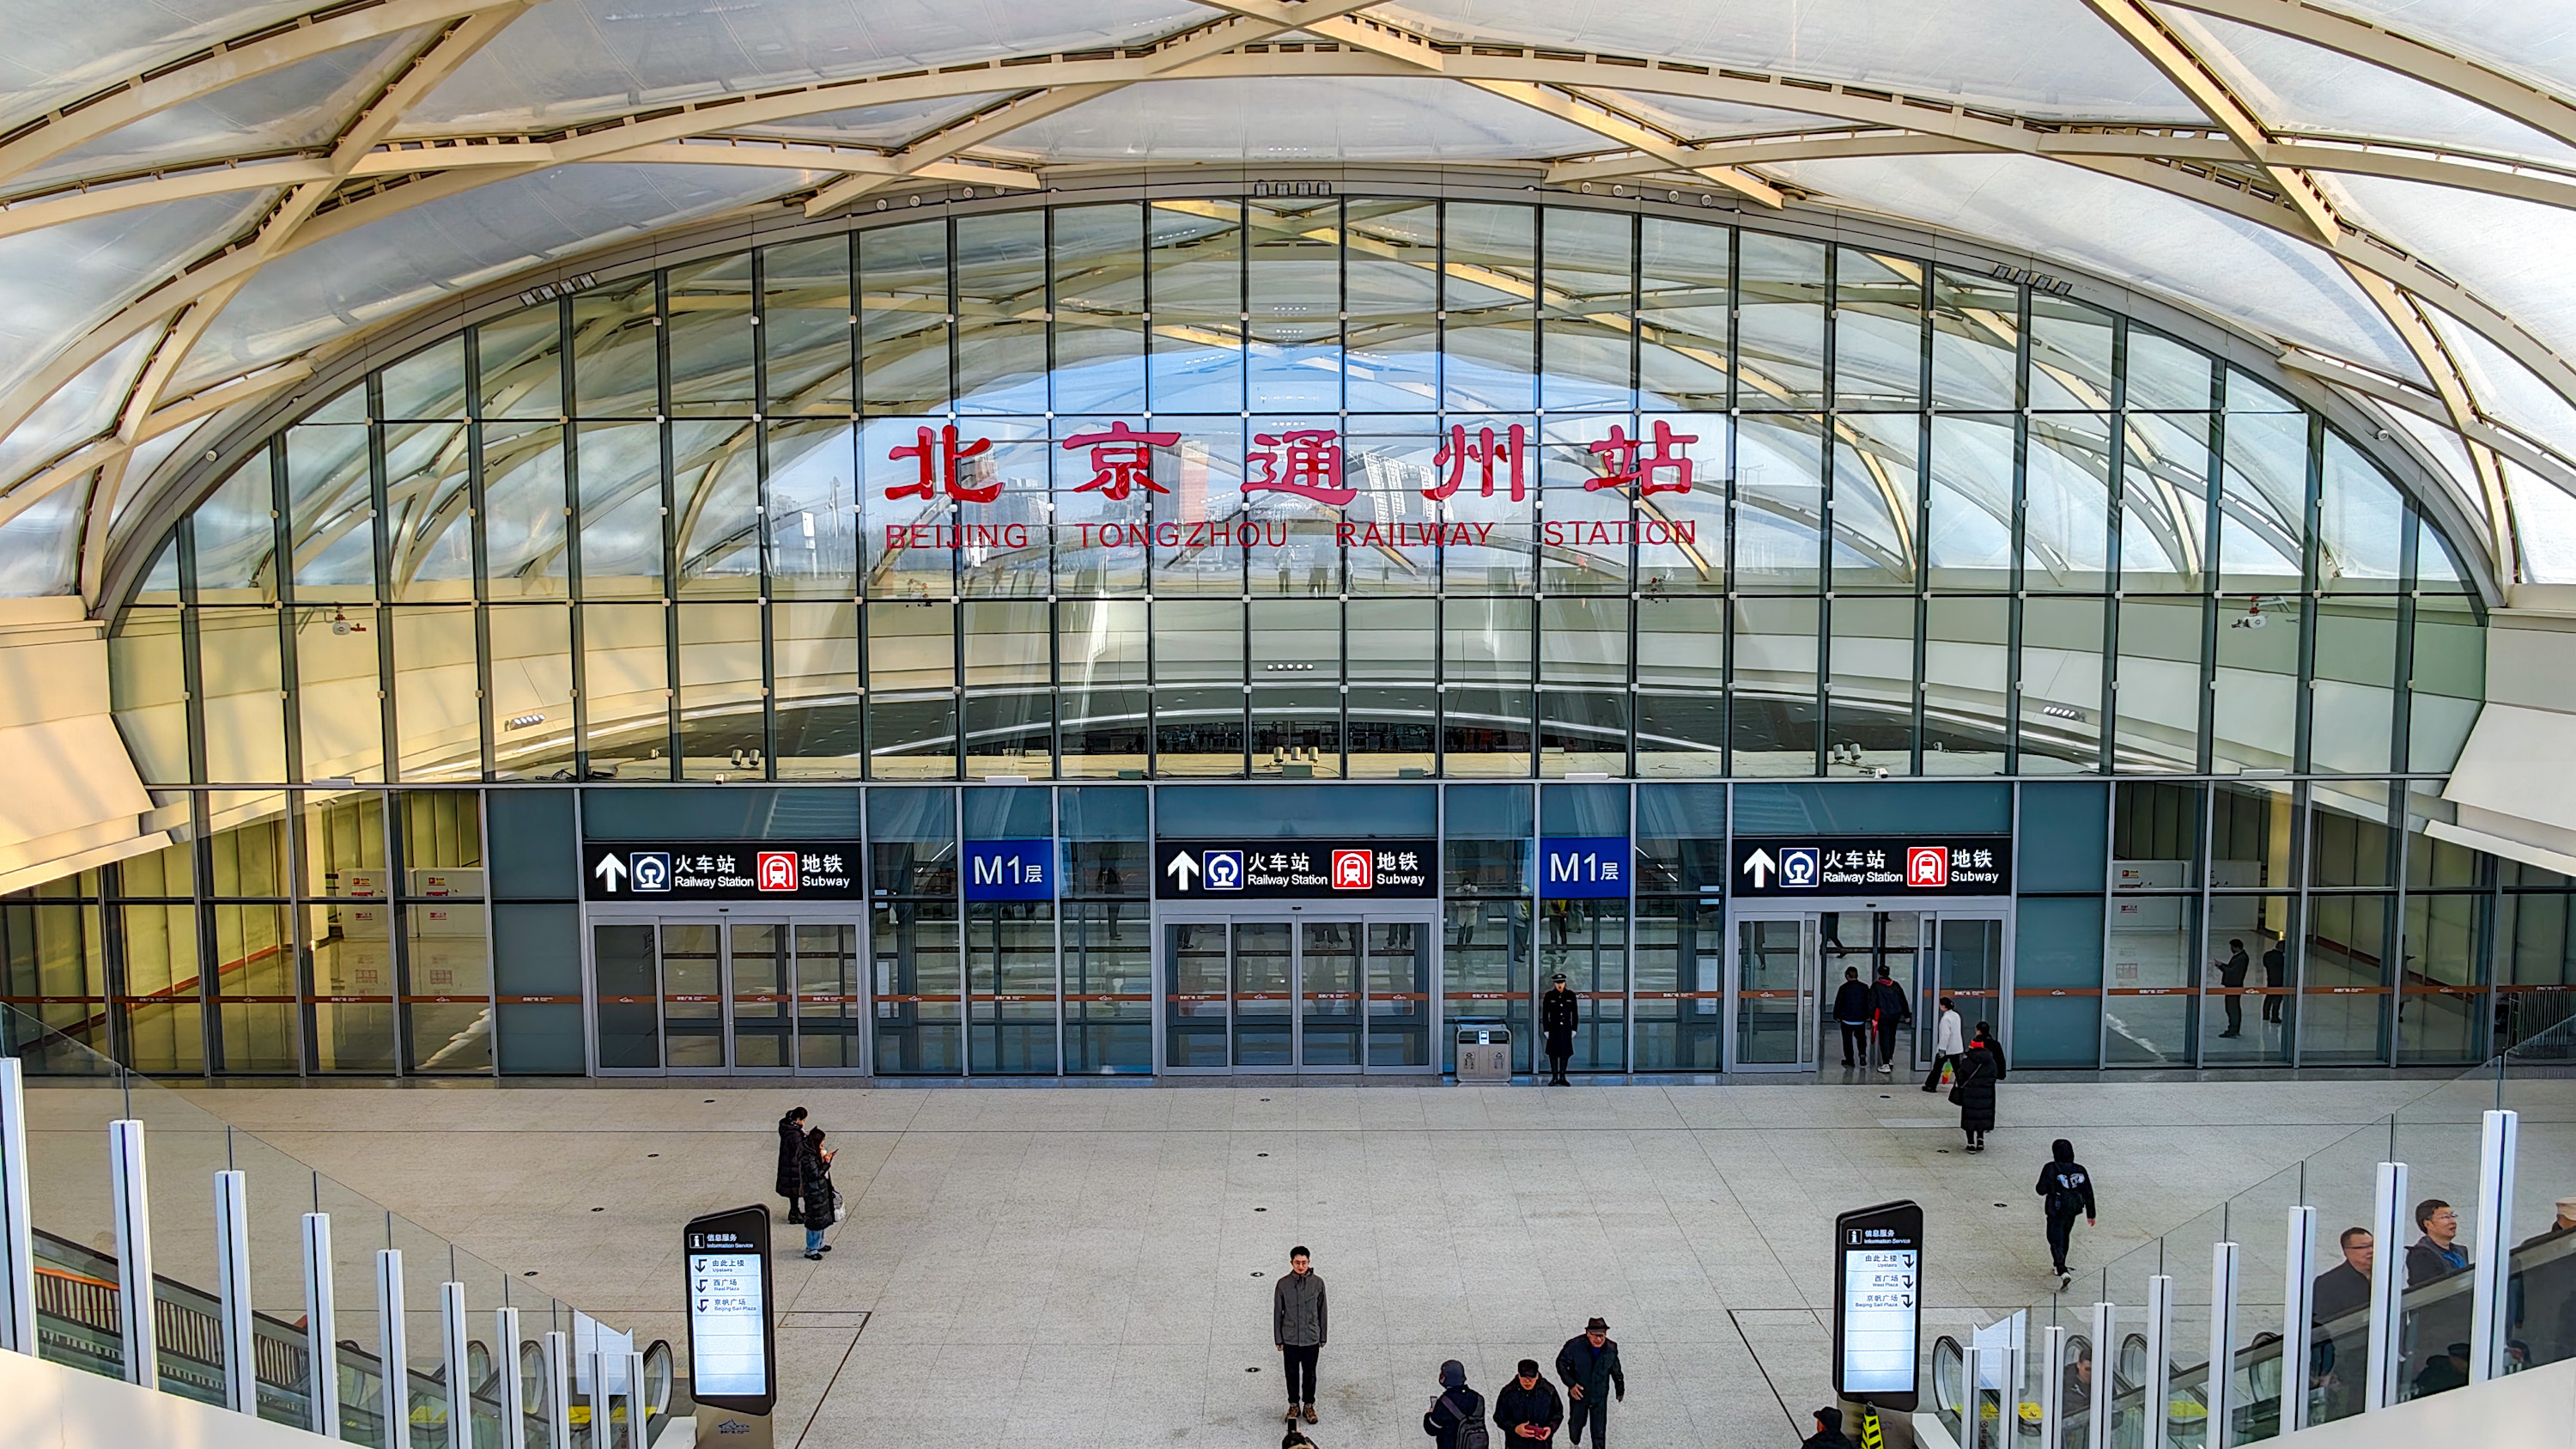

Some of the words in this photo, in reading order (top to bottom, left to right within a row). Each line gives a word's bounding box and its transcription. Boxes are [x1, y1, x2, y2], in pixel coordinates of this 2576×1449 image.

[885, 421, 1695, 502] 北京通州站
[886, 523, 1027, 549] BEIJING
[1075, 521, 1288, 548] TONGZHOU
[1335, 521, 1495, 547] RAILWAY
[1545, 521, 1696, 546] STATION
[676, 855, 735, 874] 火车站
[802, 854, 843, 873] 地铁
[1248, 853, 1309, 872] 火车站
[1376, 852, 1419, 871] 地铁
[1551, 853, 1619, 882] M1层
[1823, 850, 1885, 869] 火车站
[1952, 849, 1992, 868] 地铁
[975, 855, 1042, 885] M1层
[1823, 872, 1864, 885] Railway
[1866, 872, 1903, 883] Station
[1951, 871, 1999, 884] Subway
[675, 876, 715, 889] Railway
[717, 876, 754, 887] Station
[802, 876, 849, 889] Subway
[1248, 874, 1289, 886] Railway
[1291, 874, 1327, 886] Station
[1376, 874, 1425, 886] Subway
[707, 1233, 737, 1242] 信息服务
